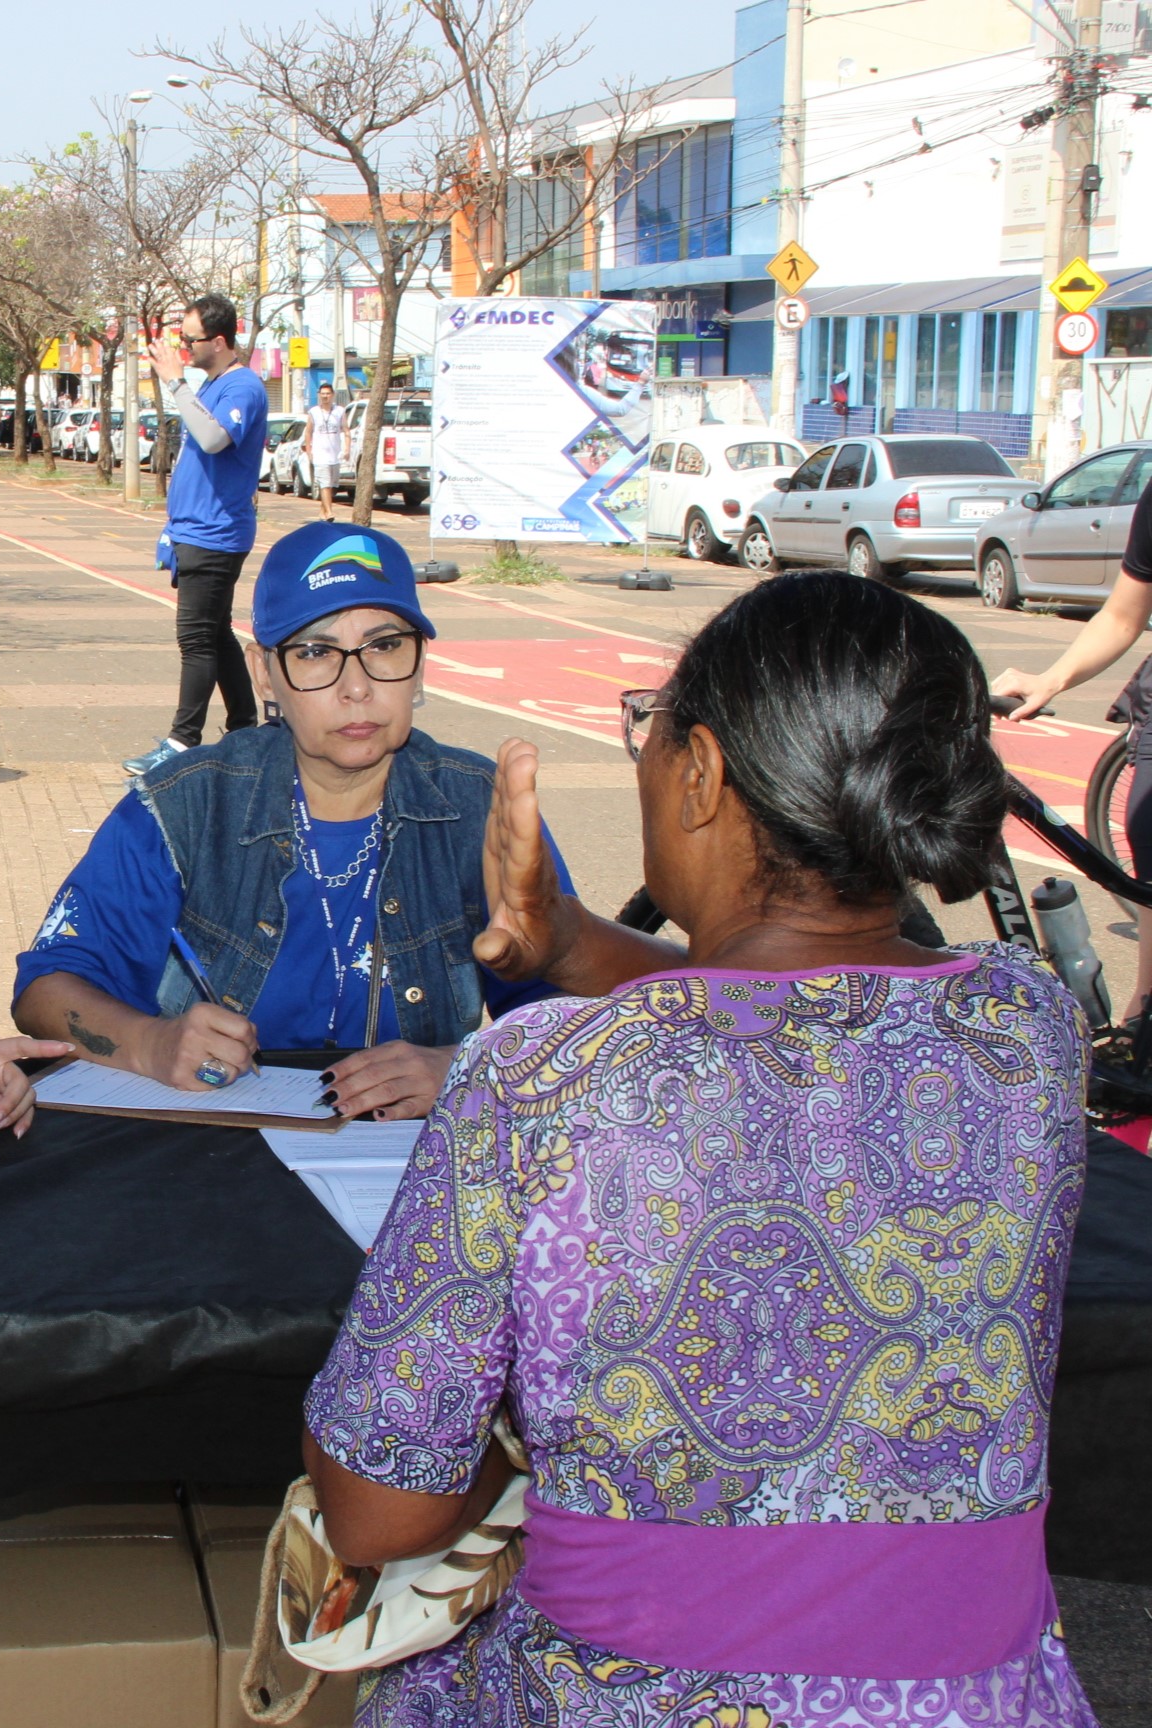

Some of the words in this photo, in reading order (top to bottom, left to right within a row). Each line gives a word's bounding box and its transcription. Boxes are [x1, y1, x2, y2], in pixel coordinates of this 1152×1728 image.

[474, 310, 555, 326] EMDEC
[655, 291, 697, 327] gibank
[787, 304, 798, 323] E
[1068, 321, 1087, 338] 30
[450, 419, 490, 427] Transporte
[447, 475, 484, 484] Educação
[536, 523, 581, 532] CAMPINAS
[308, 569, 332, 584] BRT
[309, 574, 357, 591] CAMPINAS
[299, 801, 309, 825] EMDEC
[310, 849, 320, 874] EMDEC
[363, 875, 374, 899] EMDEC
[322, 898, 331, 923] EMDEC
[348, 922, 360, 947] EMDEC
